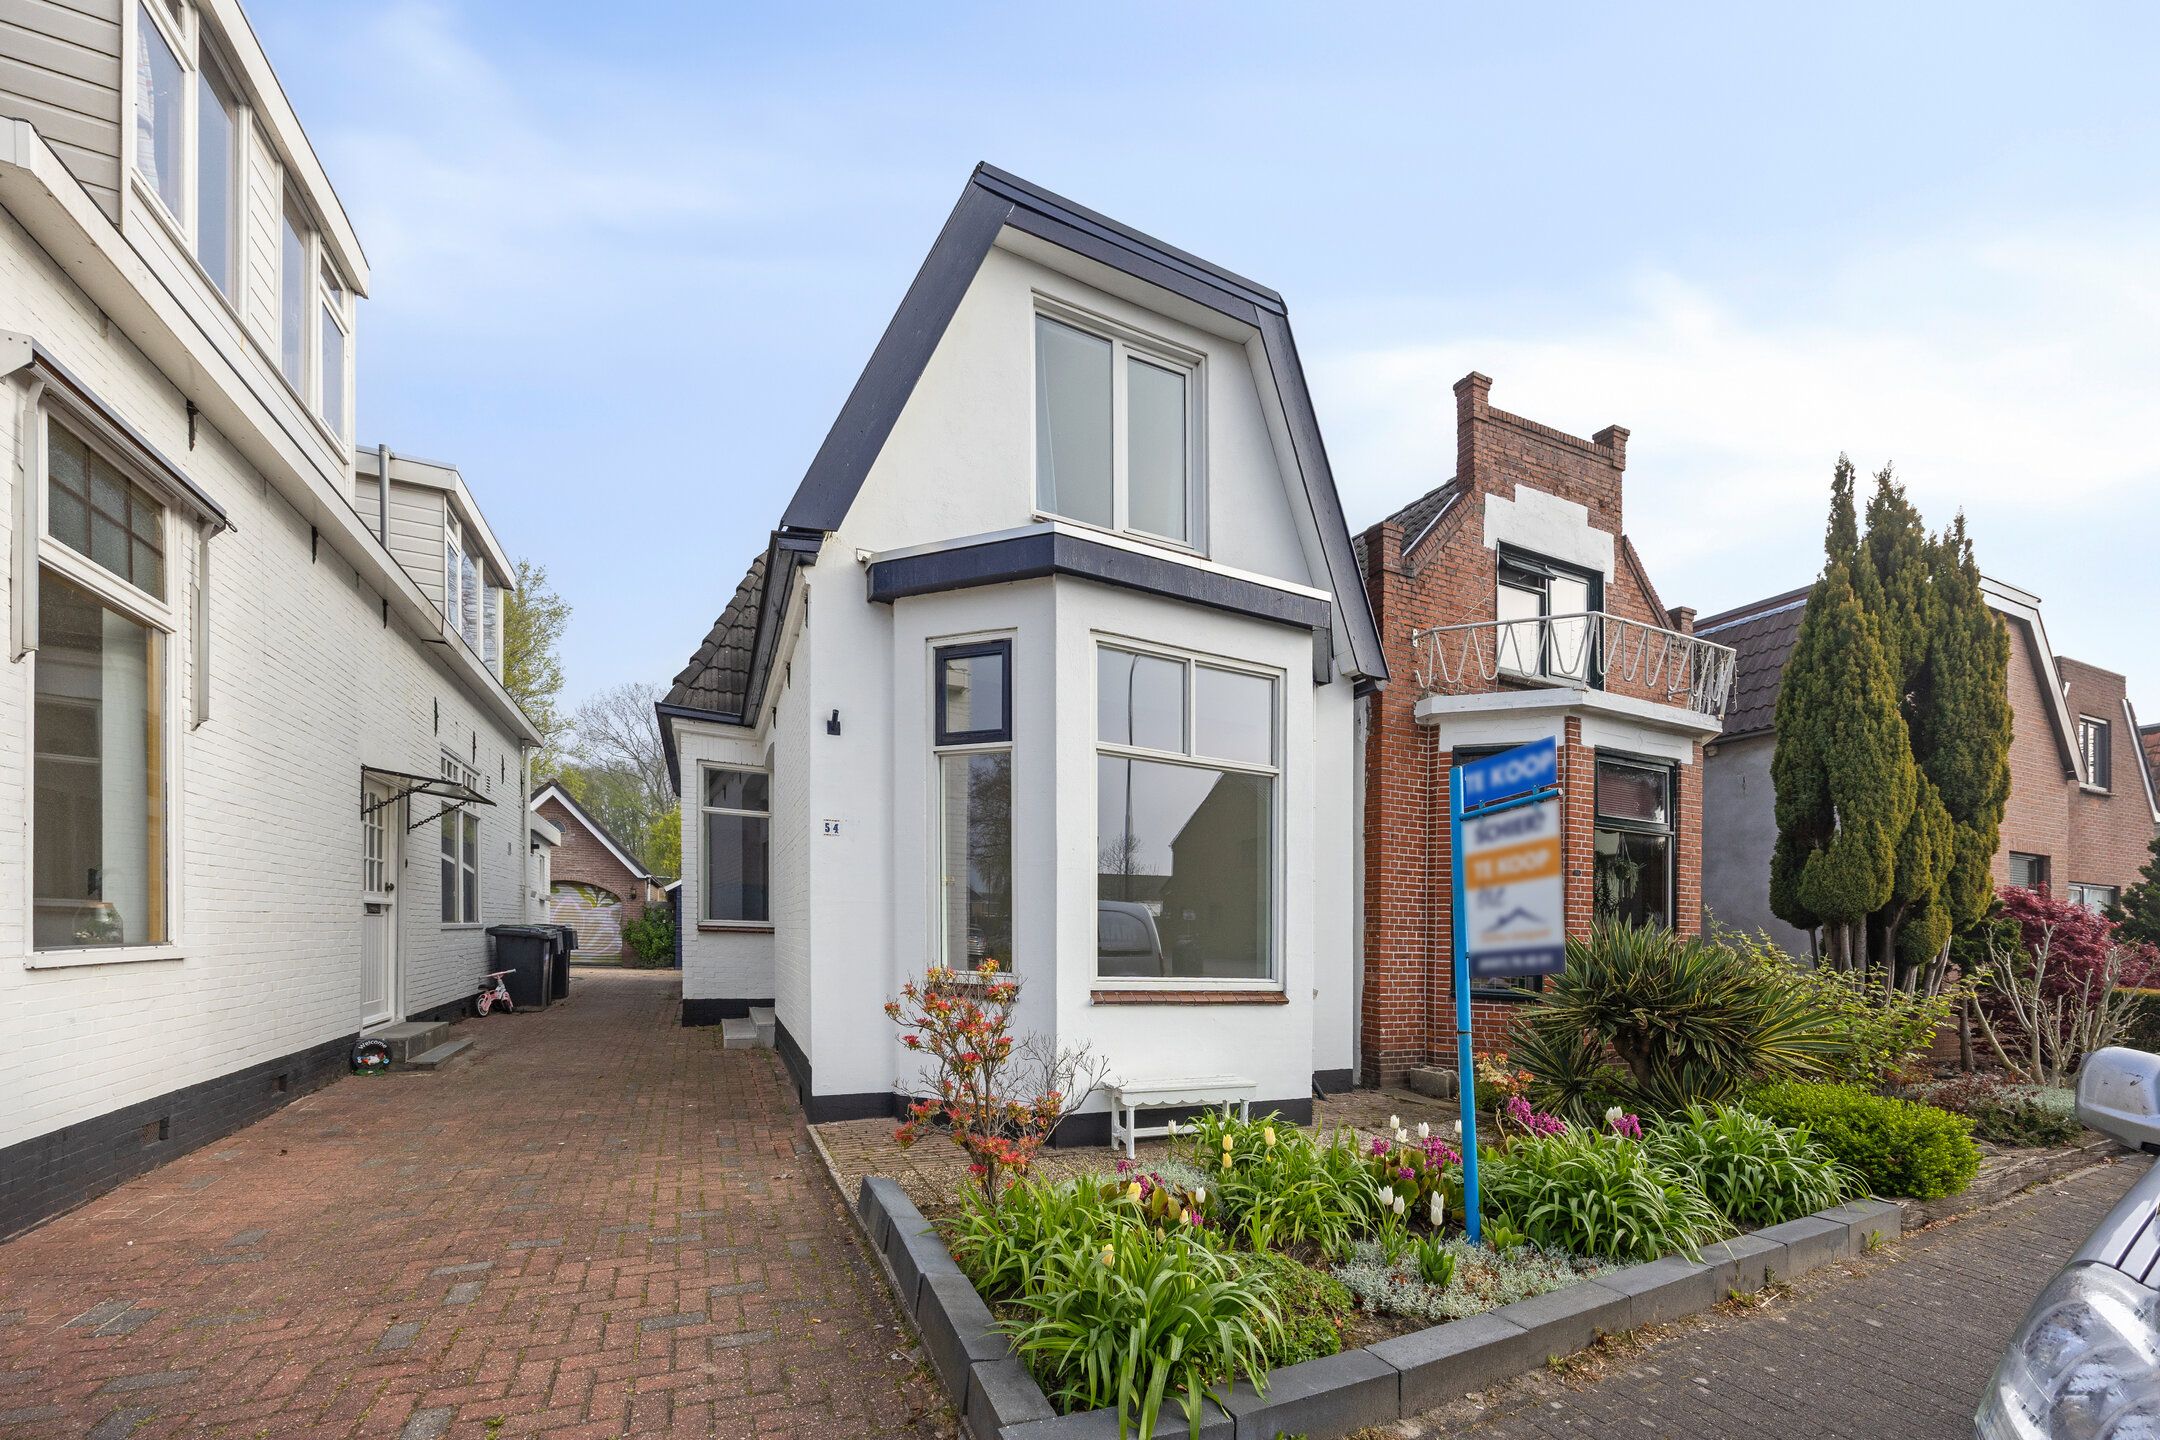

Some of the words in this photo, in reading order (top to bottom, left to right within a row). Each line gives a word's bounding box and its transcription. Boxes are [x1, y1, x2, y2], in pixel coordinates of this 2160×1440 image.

[1489, 749, 1553, 788] KOOP
[825, 822, 839, 834] 54
[1496, 849, 1550, 876] KOOP
[358, 1040, 387, 1049] Welcome
